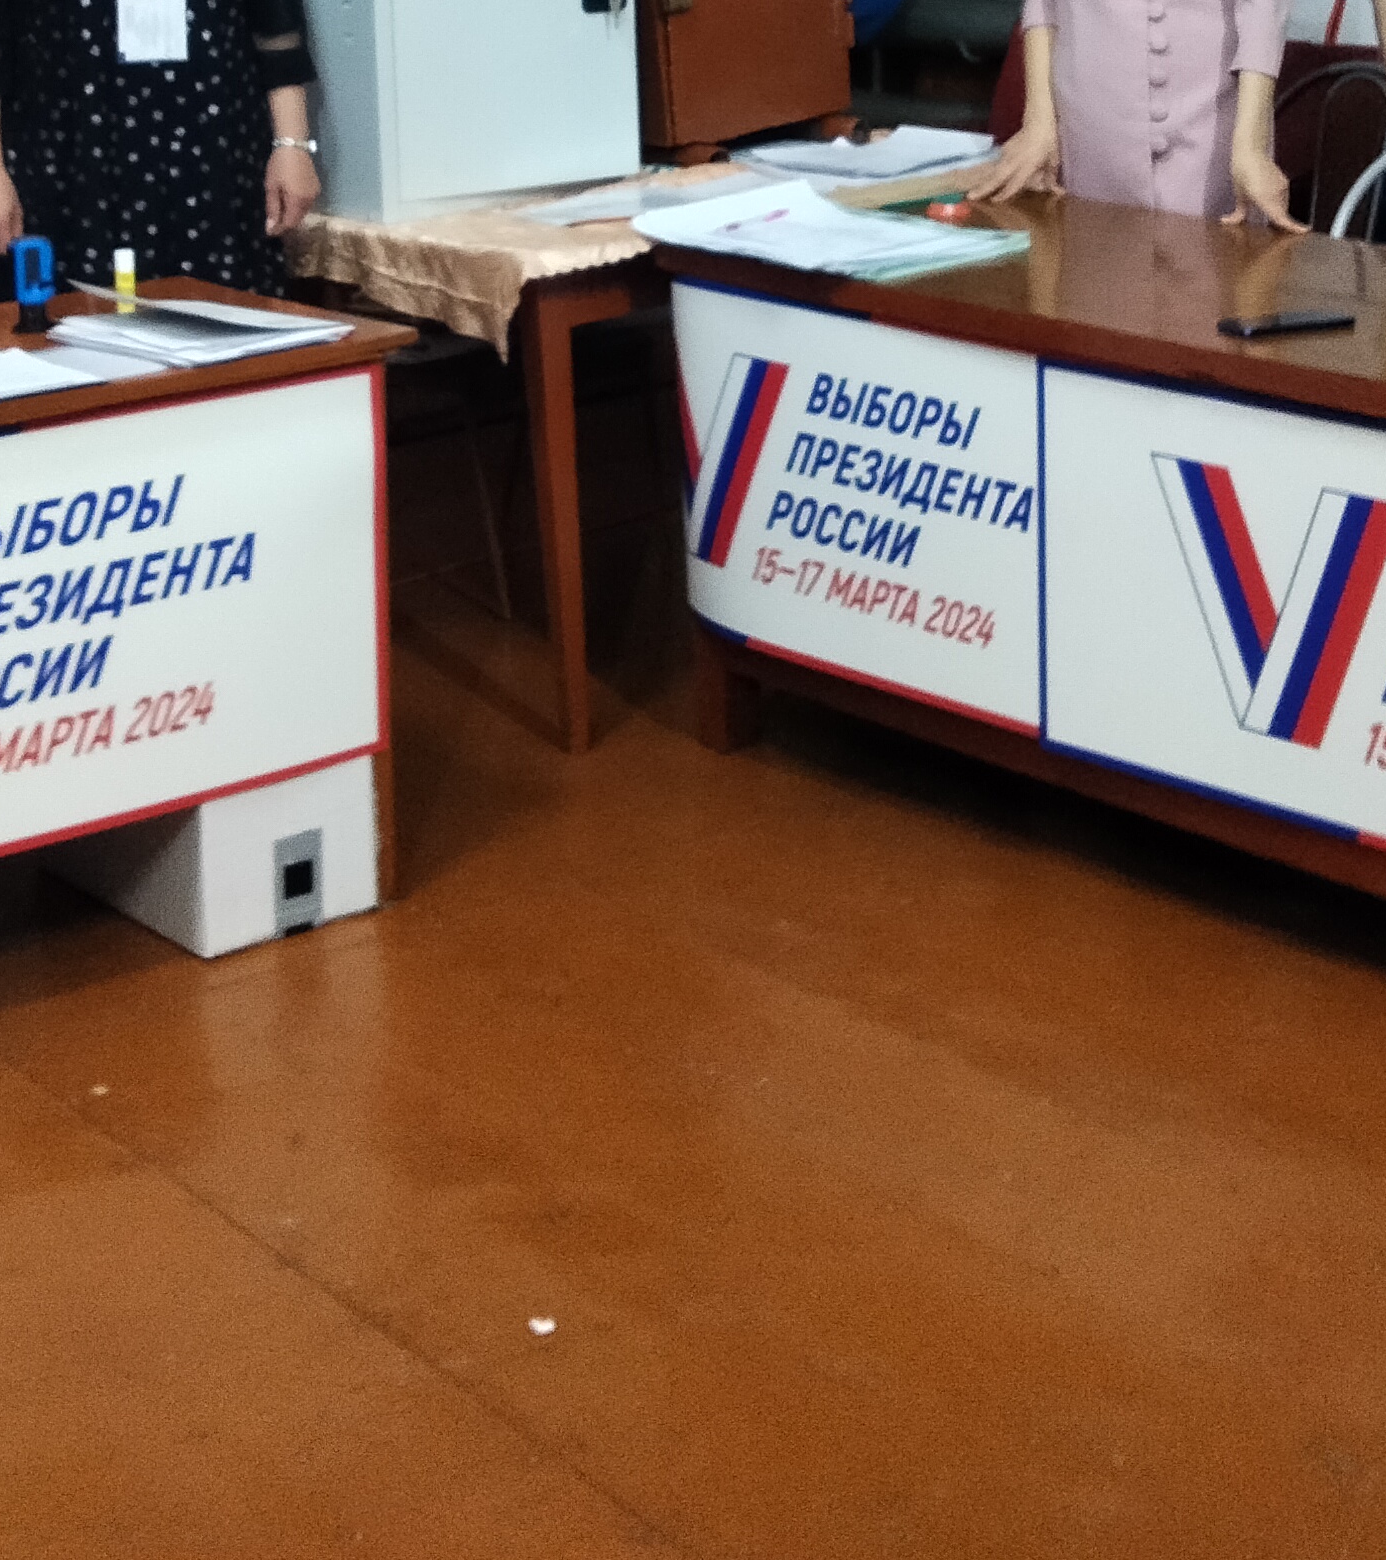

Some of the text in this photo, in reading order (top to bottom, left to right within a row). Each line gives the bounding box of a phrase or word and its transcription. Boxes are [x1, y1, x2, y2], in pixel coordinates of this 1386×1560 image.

[806, 372, 982, 450] ВЫБОРЫ
[785, 433, 1035, 533] ПРЕЗИДЕНТА
[765, 490, 922, 568] РОССИИ
[825, 567, 921, 627] МАРТА
[923, 595, 997, 650] 2024
[123, 682, 216, 747] 2024
